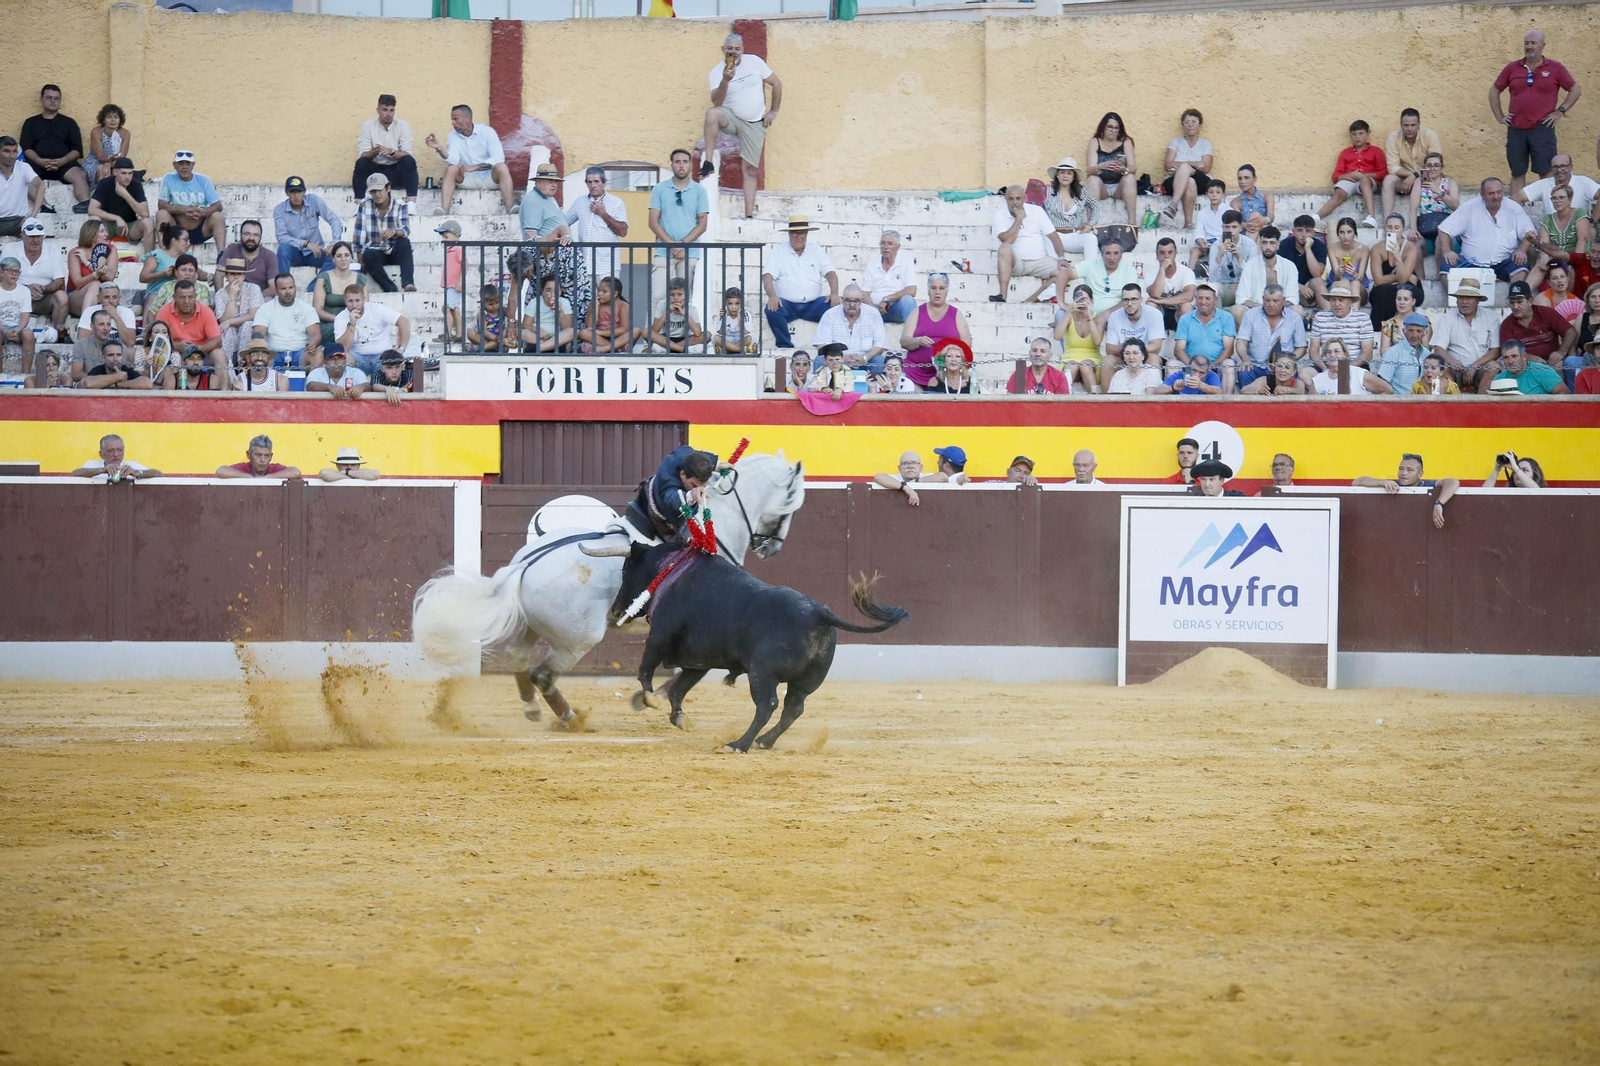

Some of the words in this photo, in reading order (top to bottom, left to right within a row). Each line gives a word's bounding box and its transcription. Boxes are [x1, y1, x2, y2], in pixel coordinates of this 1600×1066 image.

[923, 204, 931, 212] 4
[905, 234, 913, 242] 4
[1010, 284, 1017, 292] 6
[423, 301, 438, 310] 76
[965, 310, 972, 319] 5
[1026, 312, 1033, 321] 6
[417, 325, 432, 334] 74
[1025, 336, 1032, 345] 6
[507, 367, 693, 394] TORILES
[1201, 440, 1222, 460] 4
[1159, 576, 1299, 614] Mayfra
[1173, 619, 1212, 631] OBRAS
[1215, 620, 1223, 631] Y
[1225, 620, 1284, 632] SERVICIOS
